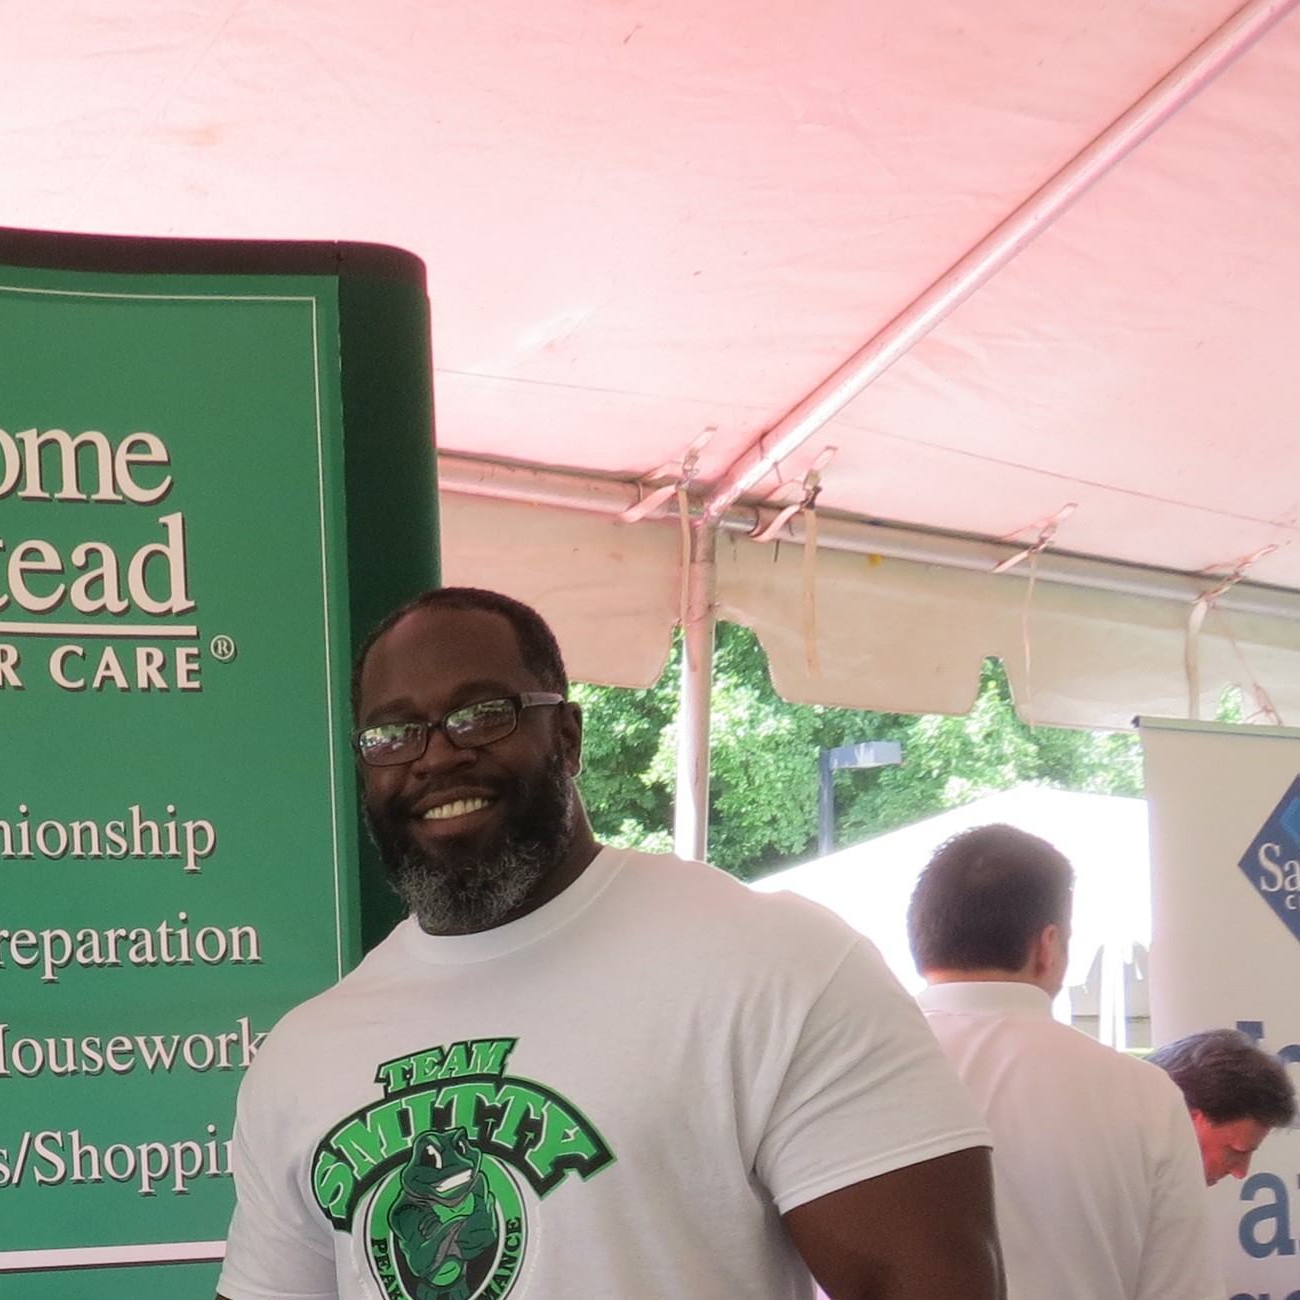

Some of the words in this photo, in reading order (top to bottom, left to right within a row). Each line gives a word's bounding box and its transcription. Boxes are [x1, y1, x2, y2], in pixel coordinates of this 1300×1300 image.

[48, 643, 202, 692] CARE
[378, 1039, 516, 1094] TEAM
[312, 1080, 602, 1224] SMITTY
